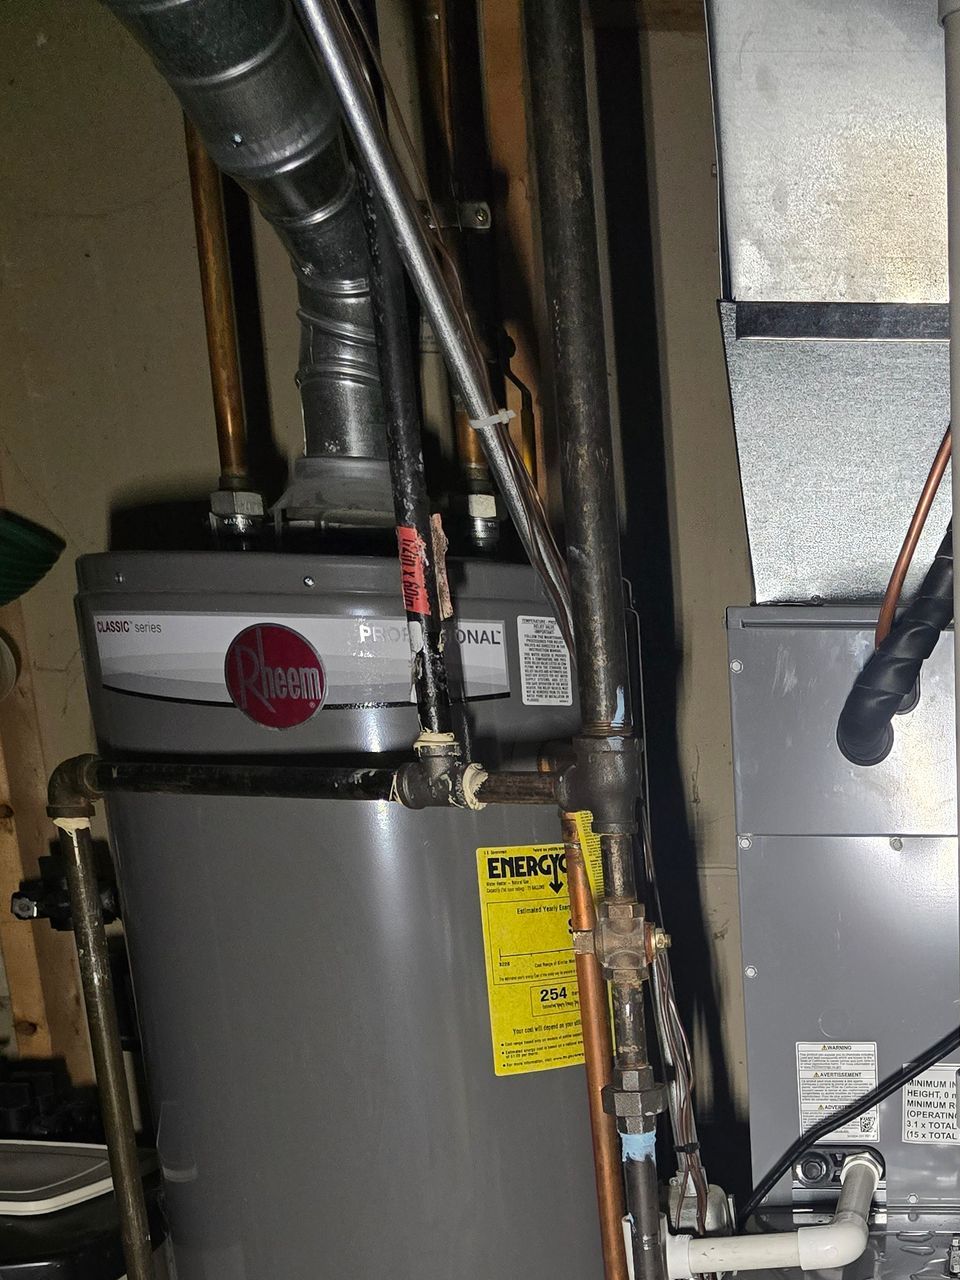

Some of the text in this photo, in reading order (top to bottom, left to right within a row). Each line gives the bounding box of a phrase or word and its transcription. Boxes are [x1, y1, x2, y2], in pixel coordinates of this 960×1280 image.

[97, 620, 130, 633] CLASSIC
[135, 621, 162, 634] series
[233, 627, 322, 713] Rheem
[517, 906, 542, 914] Estimated
[542, 905, 558, 913] Yearly
[540, 986, 568, 1002] 254
[907, 1090, 942, 1099] HEIGHT,
[907, 1100, 946, 1109] MINIMUM
[906, 1110, 957, 1119] (OPERATIN
[906, 1131, 919, 1139] (15
